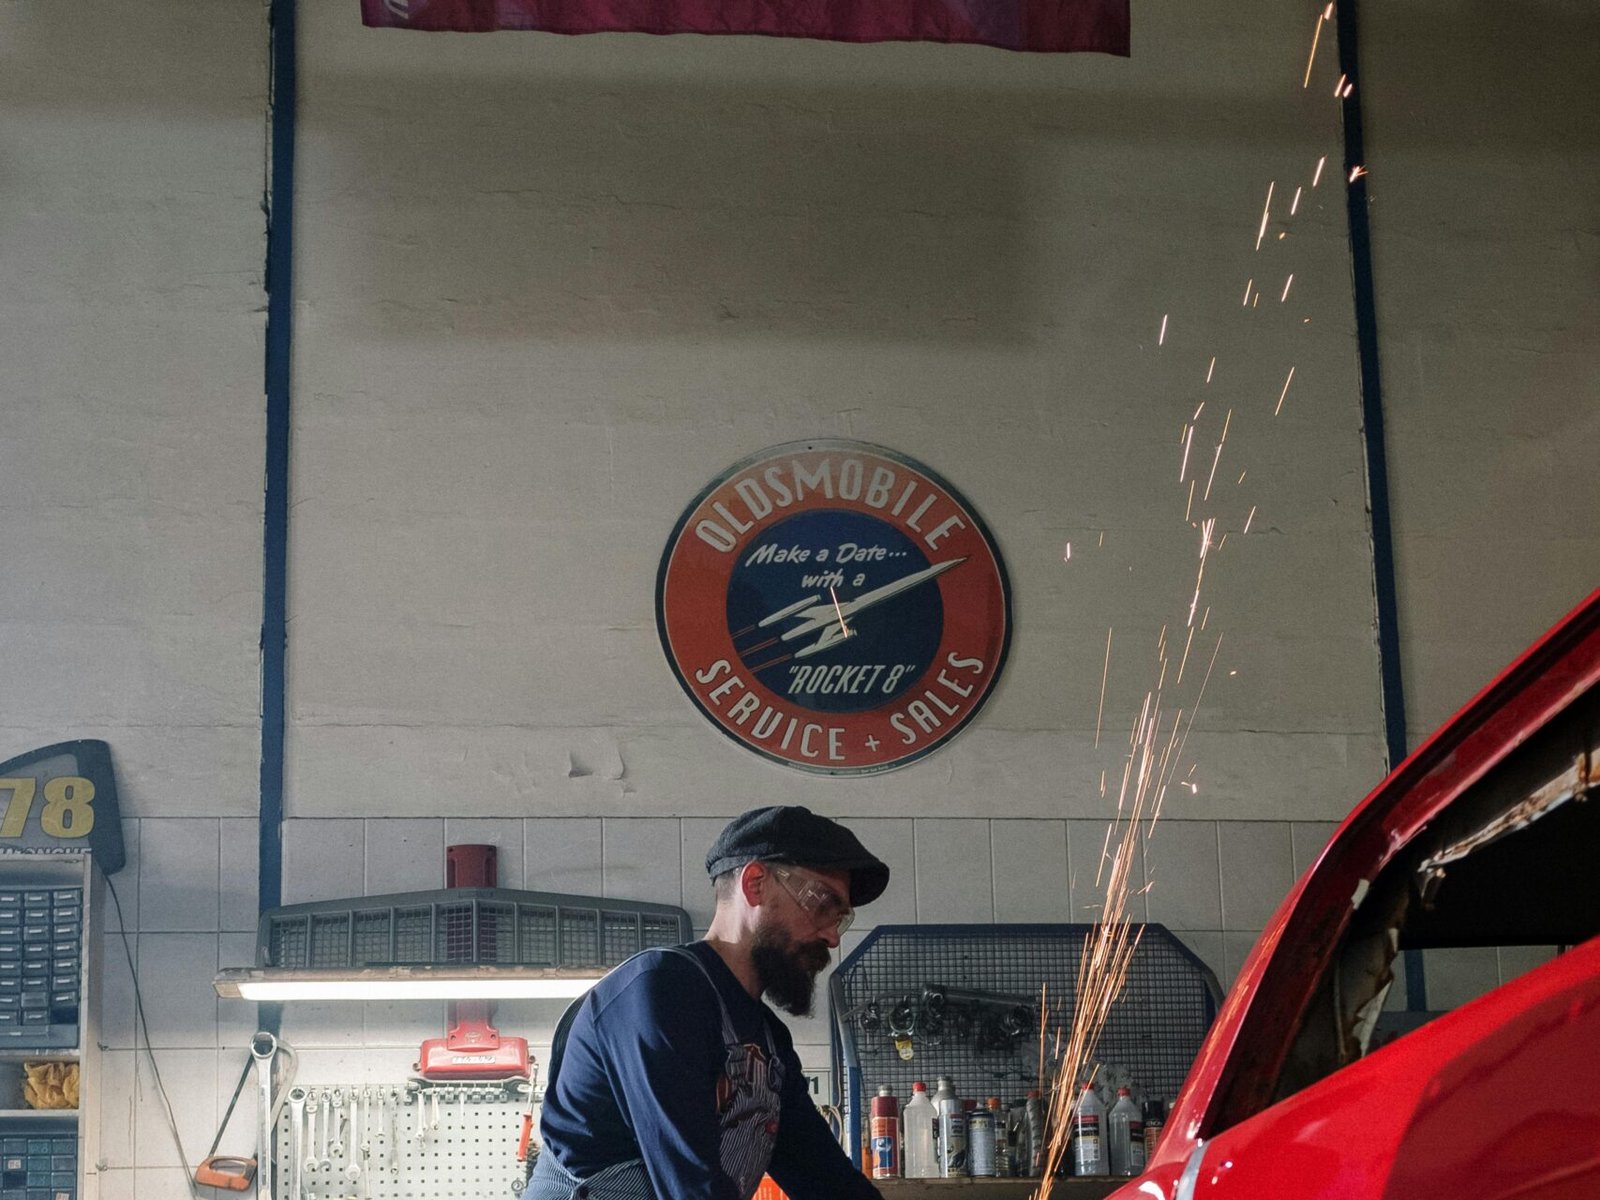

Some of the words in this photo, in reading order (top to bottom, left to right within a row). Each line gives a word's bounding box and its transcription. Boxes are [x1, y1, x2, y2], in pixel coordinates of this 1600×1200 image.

[695, 459, 966, 552] OLDSMOBILE
[745, 543, 811, 567] Make
[816, 550, 829, 562] a
[802, 568, 844, 588] with
[853, 573, 866, 586] a
[788, 665, 886, 694] "ROCKET
[882, 664, 916, 693] 8"
[696, 660, 845, 760] SERVICE
[890, 652, 984, 744] SALES
[0, 776, 95, 838] 78
